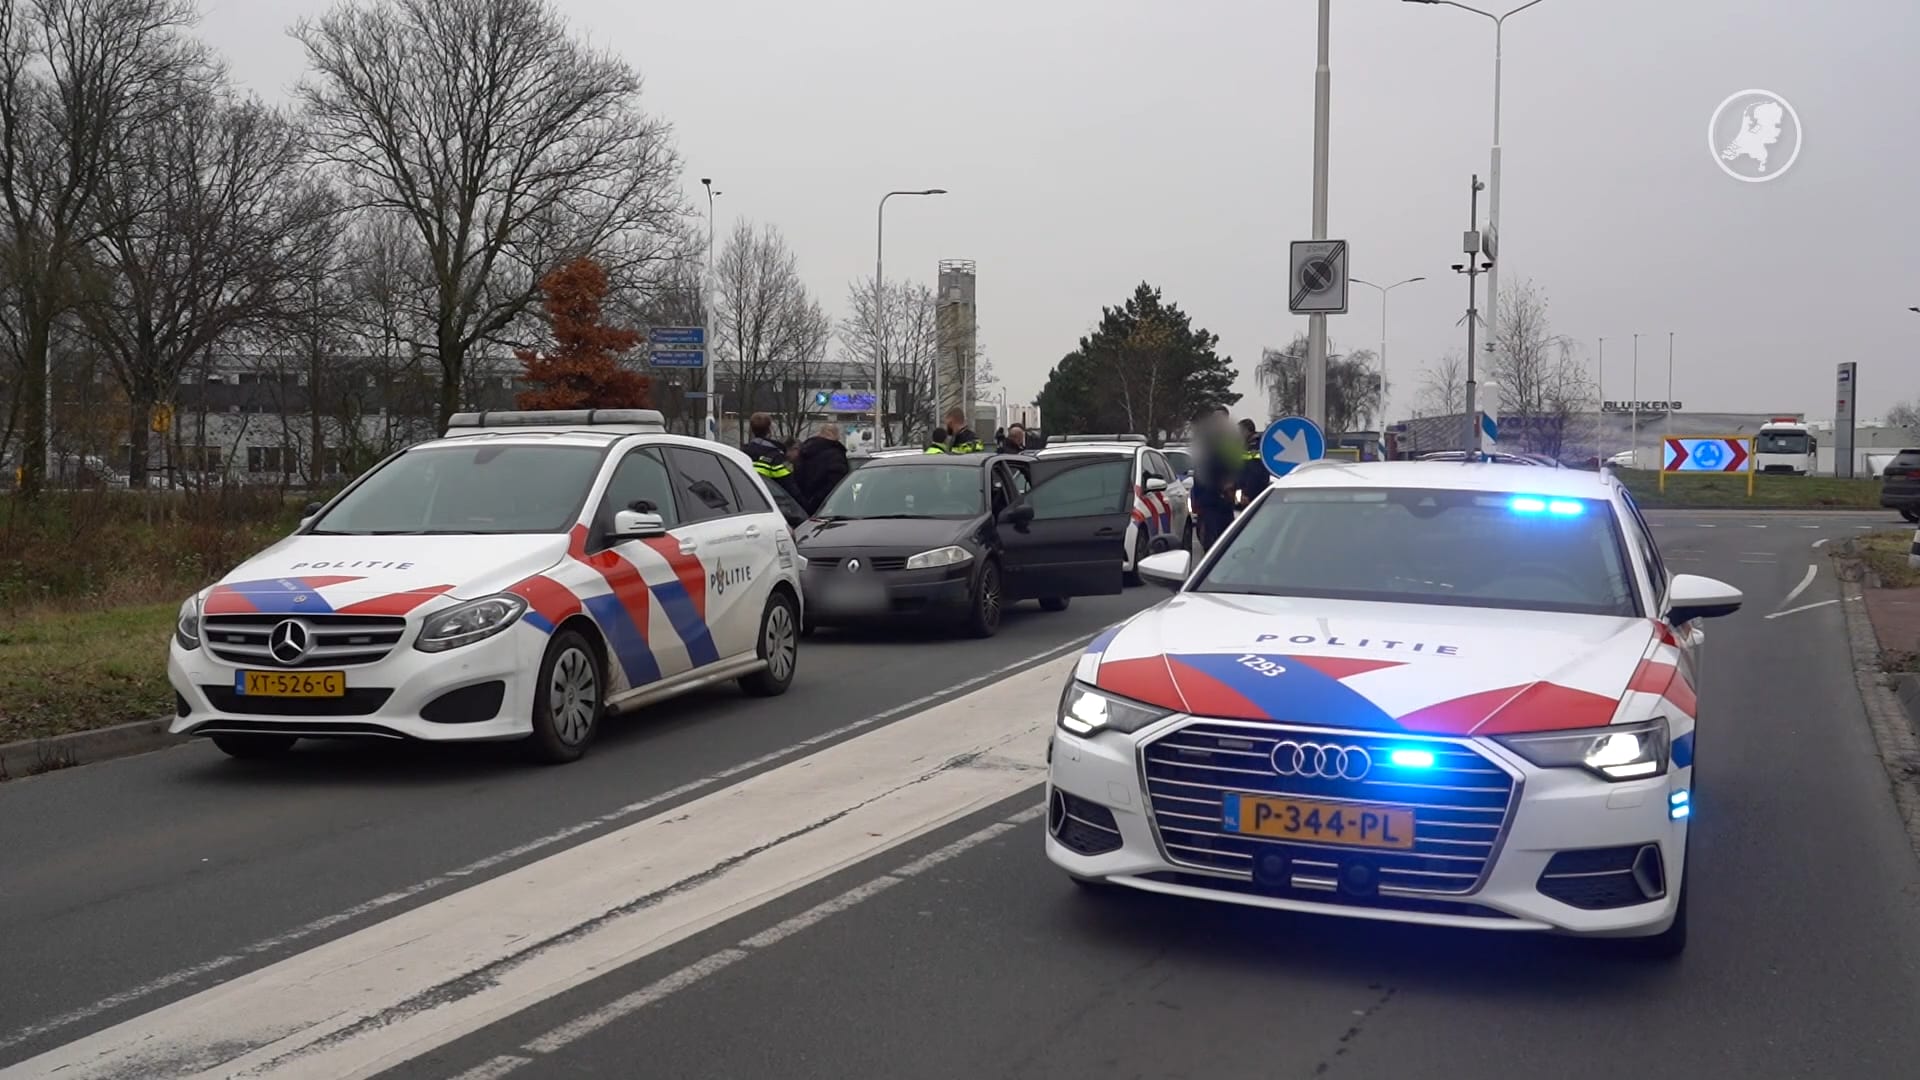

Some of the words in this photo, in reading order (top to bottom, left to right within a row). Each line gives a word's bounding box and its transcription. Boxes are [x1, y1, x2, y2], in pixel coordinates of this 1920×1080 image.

[1603, 401, 1683, 409] BLUEKENS
[290, 560, 415, 570] POLITIE
[1256, 633, 1459, 655] POLITIE
[1237, 654, 1287, 677] 1293
[251, 676, 335, 693] XT-526-G
[1255, 805, 1400, 842] P-344-PL
